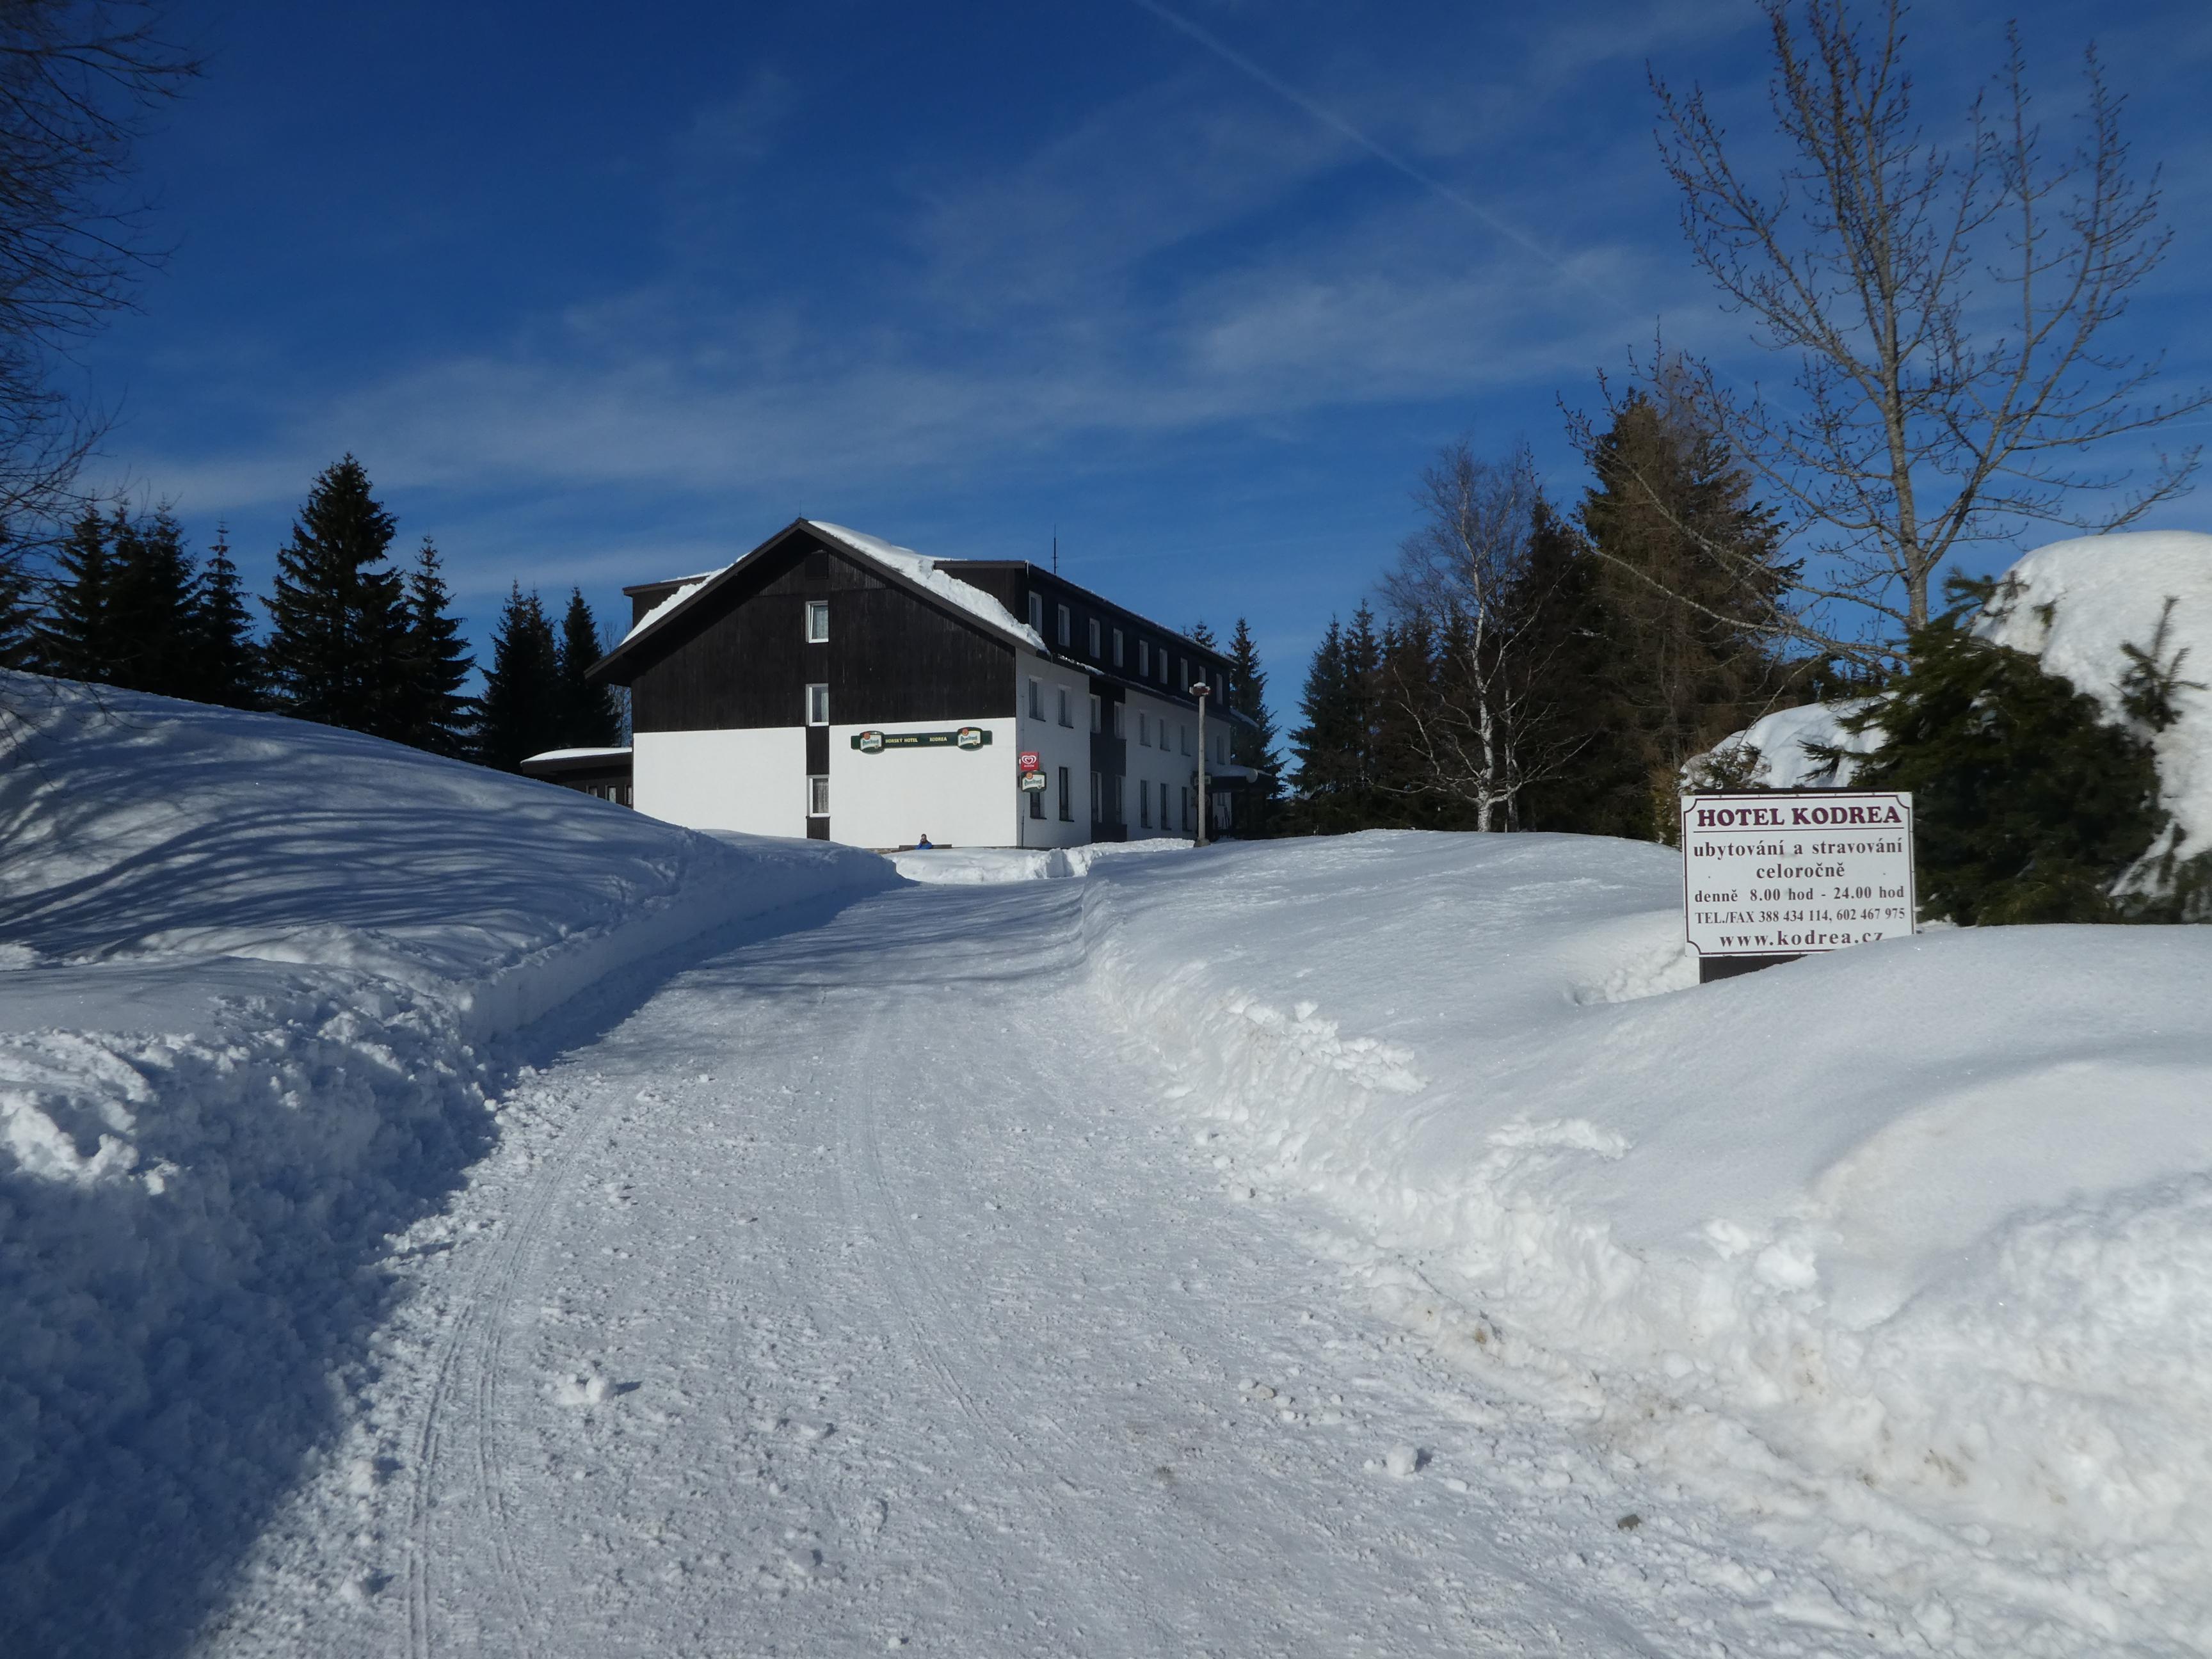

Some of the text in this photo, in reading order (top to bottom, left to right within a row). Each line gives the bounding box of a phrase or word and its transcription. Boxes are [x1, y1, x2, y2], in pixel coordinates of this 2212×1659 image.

[1697, 806, 1902, 826] HOTEL KODREA
[1694, 838, 1902, 860] ubytování a stravování
[1757, 862, 1845, 878] celoročně
[1695, 890, 1738, 902] denně
[1751, 889, 1780, 901] 8.00
[1789, 888, 1813, 900] hod
[1834, 886, 1871, 899] 24.00
[1879, 886, 1904, 898] hod
[1695, 908, 1905, 924] TEL./FAX 388 434 114, 602 467 975
